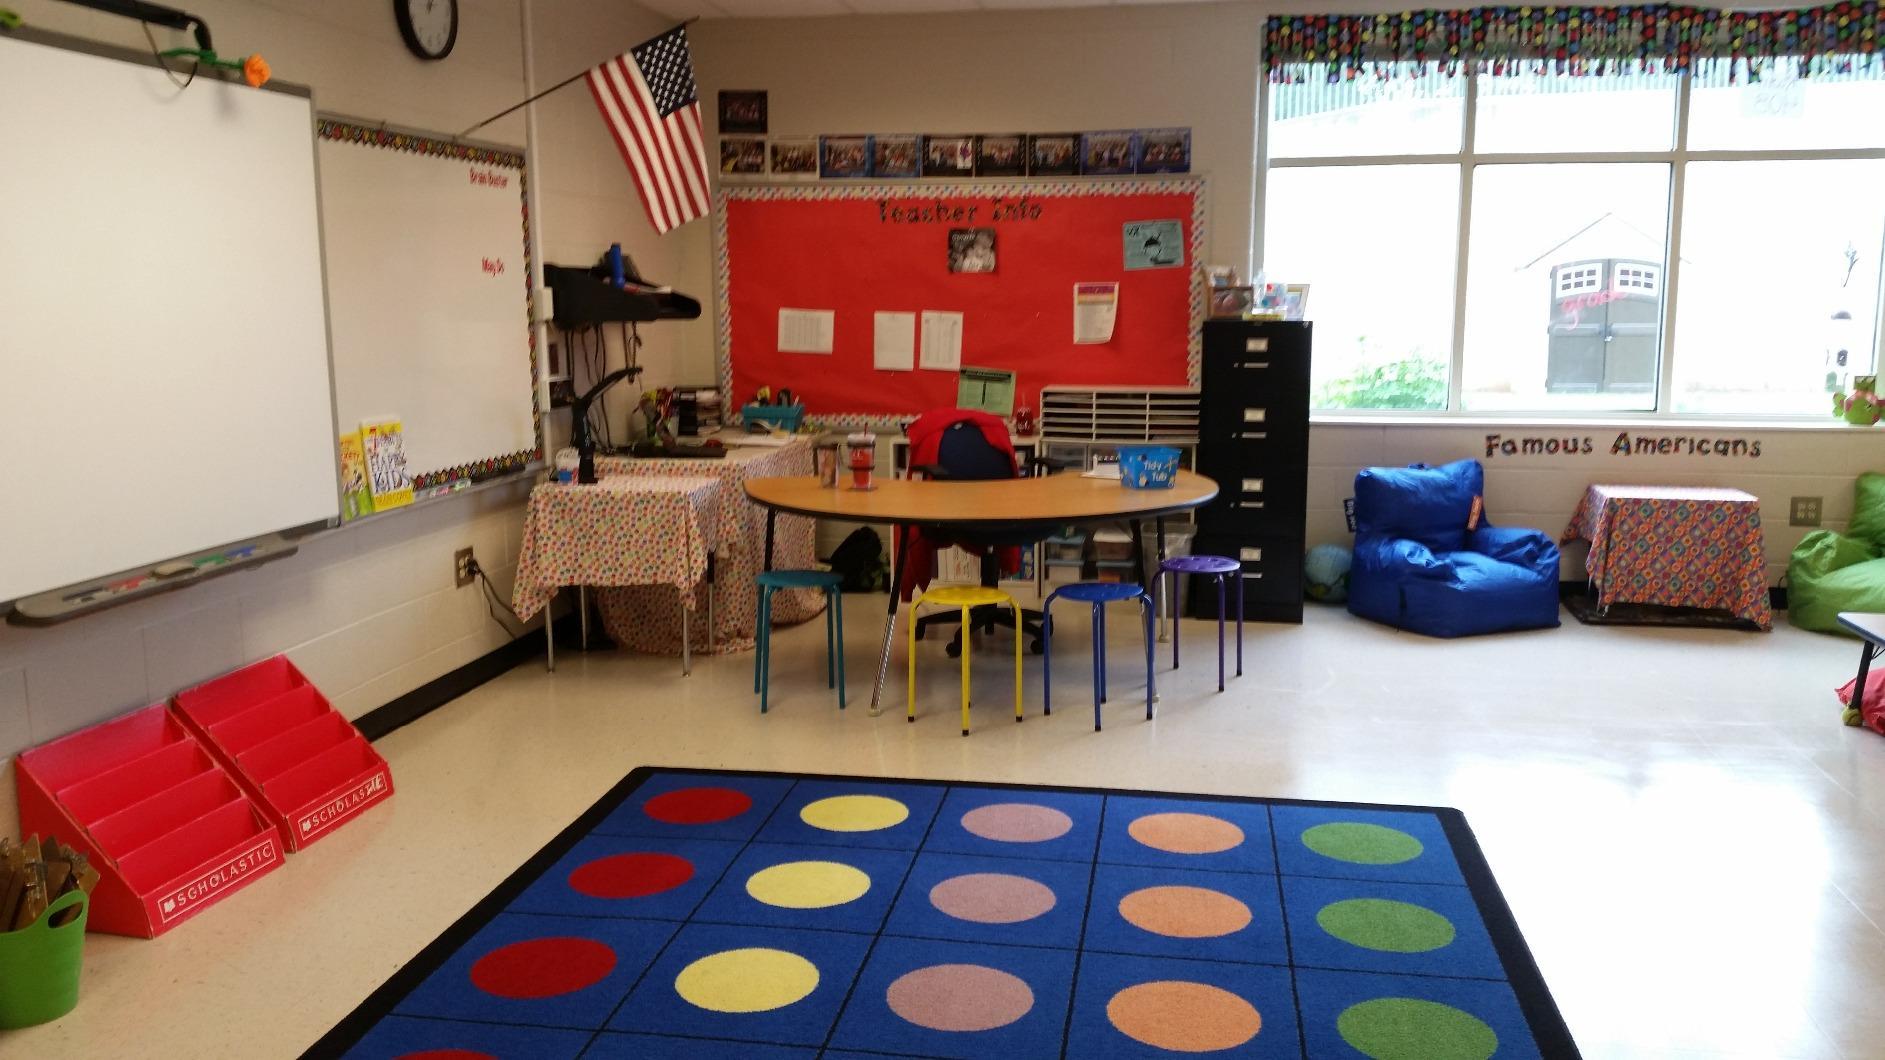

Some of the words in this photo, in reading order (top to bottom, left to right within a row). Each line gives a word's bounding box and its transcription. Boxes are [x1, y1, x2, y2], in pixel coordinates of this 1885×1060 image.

[878, 199, 978, 223] Teacher
[992, 196, 1042, 222] Info
[1485, 434, 1594, 459] Famous
[1609, 431, 1762, 459] Americans
[312, 774, 385, 828] SCHOLASTIC
[176, 845, 273, 907] SCHOLASTIC
